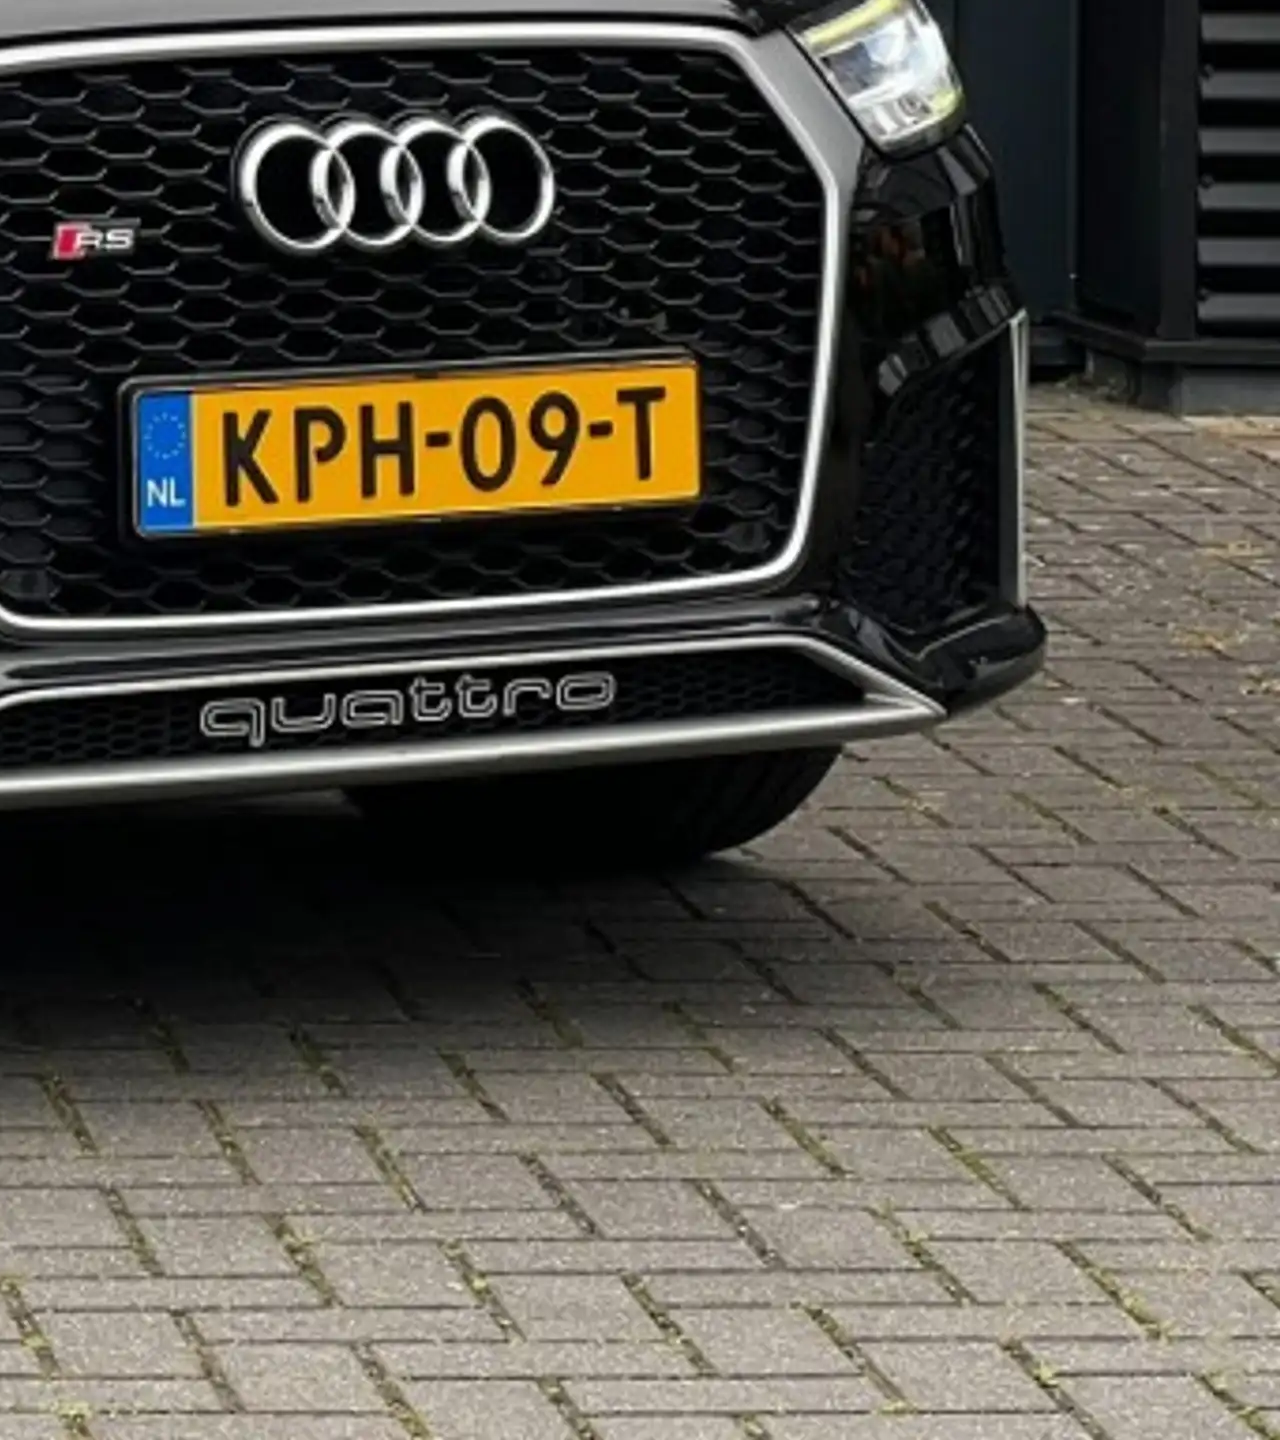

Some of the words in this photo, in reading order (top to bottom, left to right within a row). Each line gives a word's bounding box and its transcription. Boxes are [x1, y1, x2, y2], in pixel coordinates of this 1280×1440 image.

[52, 221, 135, 260] RS
[222, 386, 667, 507] KPH-09-T
[146, 477, 187, 508] NL
[200, 672, 616, 748] quattro
